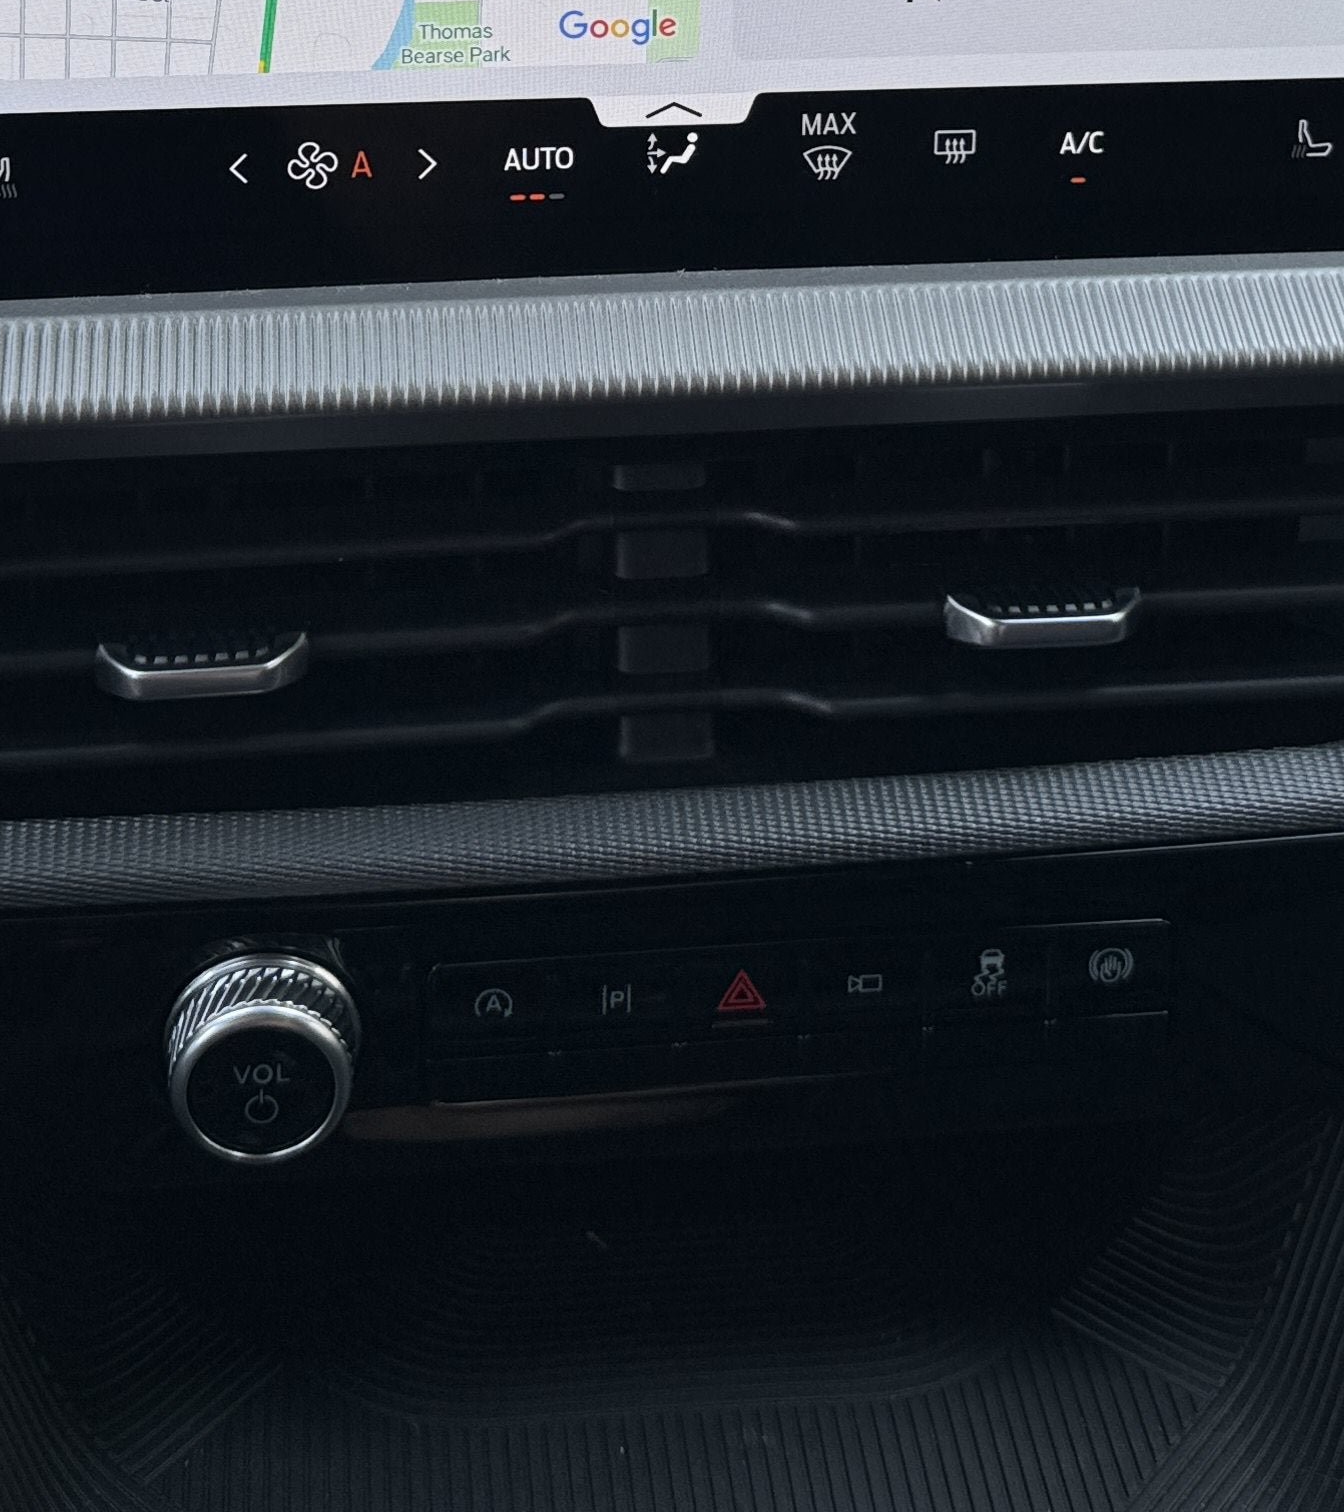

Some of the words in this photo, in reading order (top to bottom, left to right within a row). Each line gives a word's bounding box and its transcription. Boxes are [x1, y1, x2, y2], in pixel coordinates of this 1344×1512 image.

[419, 24, 493, 39] Thomas
[559, 9, 676, 45] Google
[401, 48, 464, 64] Bearse
[470, 46, 511, 62] Park
[801, 112, 857, 137] MAX
[1059, 130, 1105, 156] A/C
[350, 150, 373, 180] A
[504, 146, 574, 172] AUTO
[971, 980, 1008, 997] OFF
[233, 1063, 291, 1085] VOL
